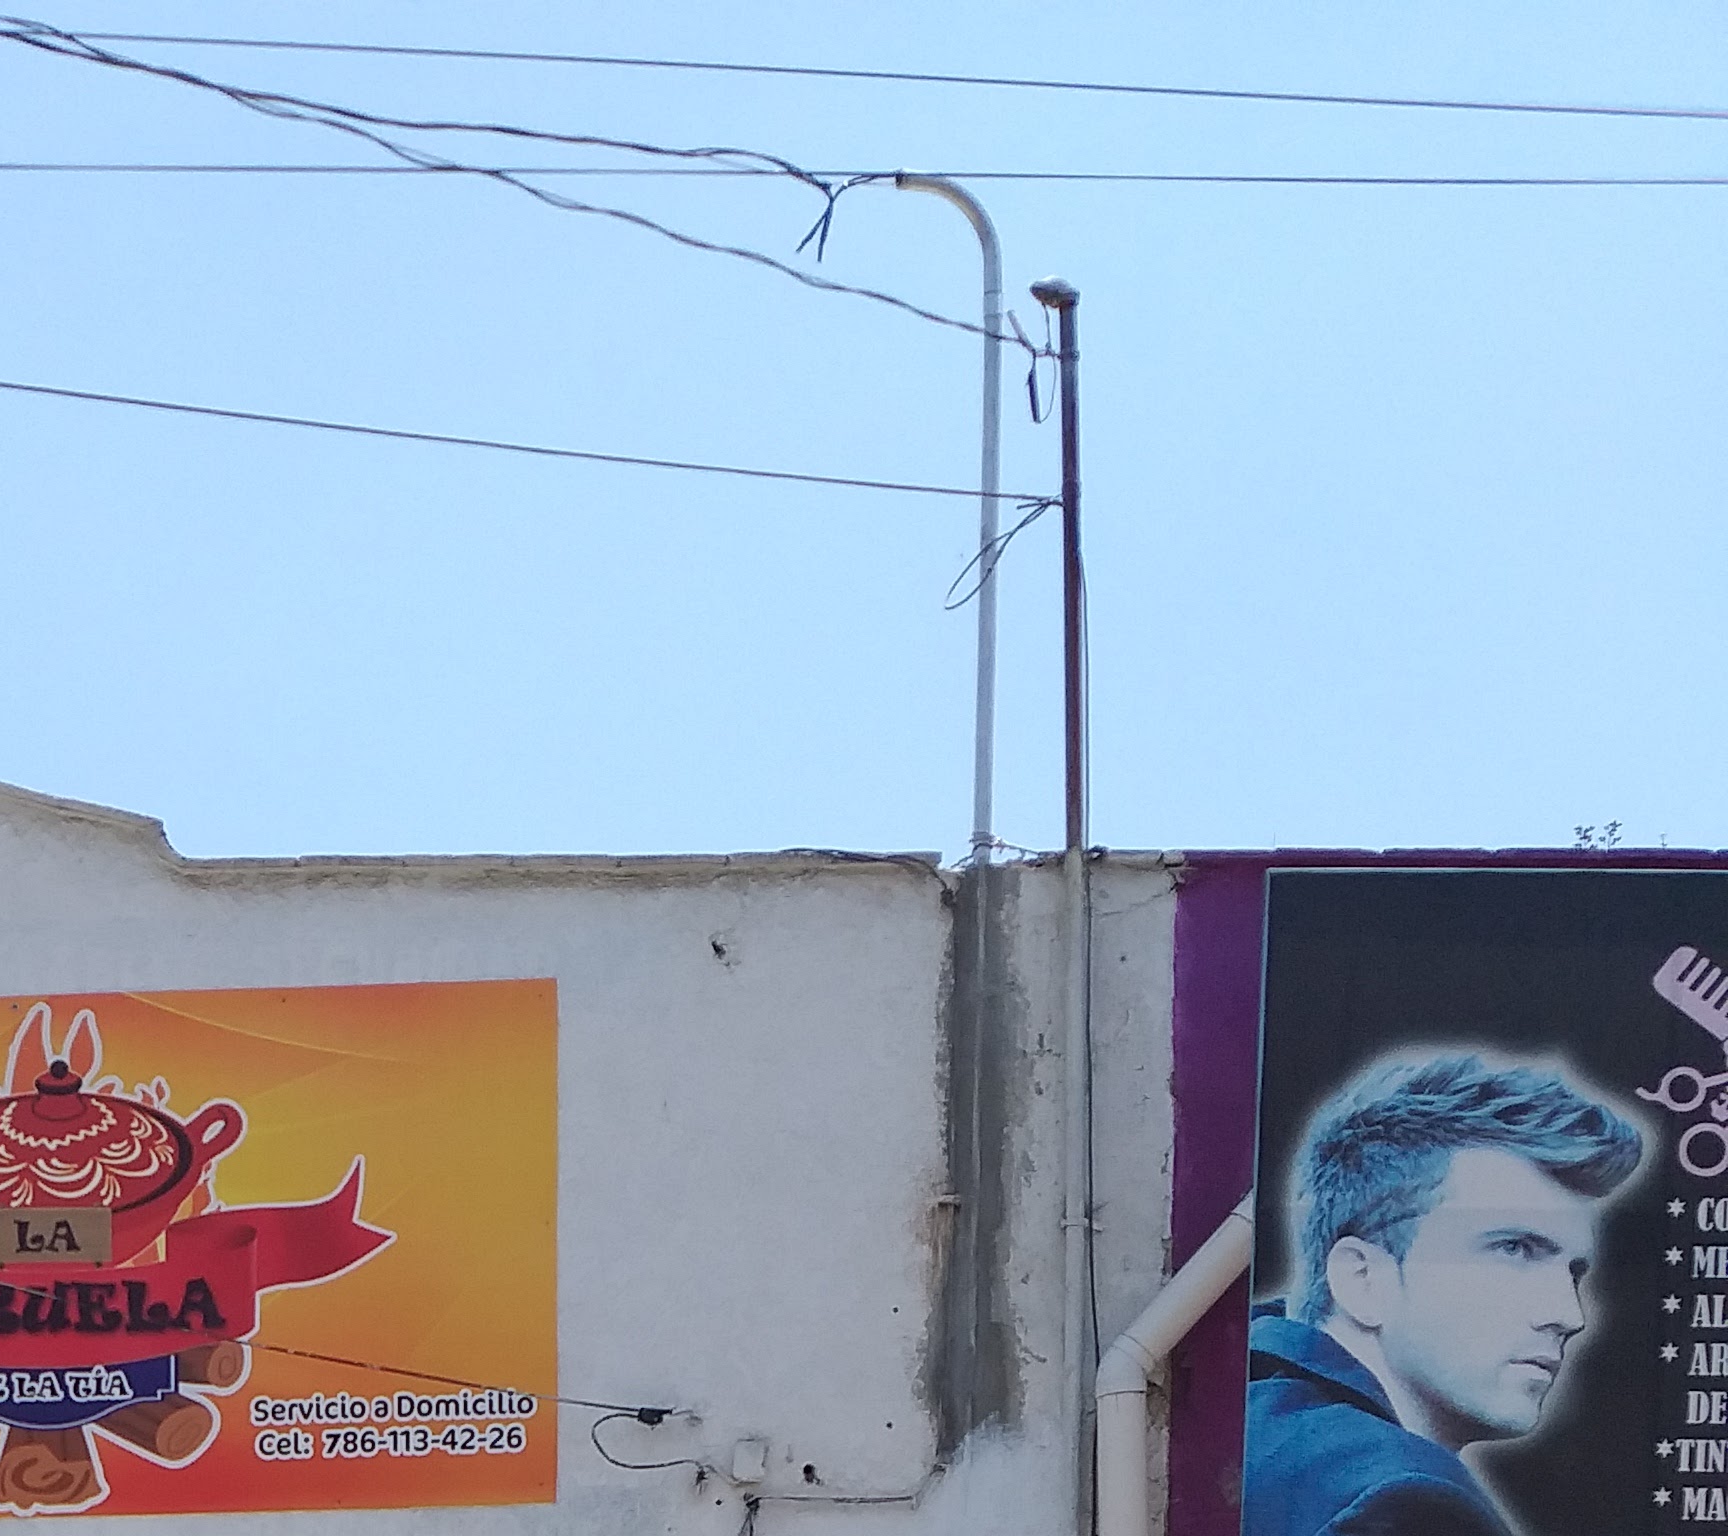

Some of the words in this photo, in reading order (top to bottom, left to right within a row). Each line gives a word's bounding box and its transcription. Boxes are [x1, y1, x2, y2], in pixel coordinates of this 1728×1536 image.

[12, 1218, 83, 1254] LA
[15, 1373, 63, 1400] LA
[252, 1393, 368, 1422] Servicio
[373, 1397, 390, 1419] a
[396, 1388, 535, 1418] Domicilio
[257, 1431, 311, 1457] Cel:
[323, 1426, 524, 1455] 786-113-42-26
[1675, 1439, 1728, 1473] TIN
[1681, 1487, 1728, 1521] MA
